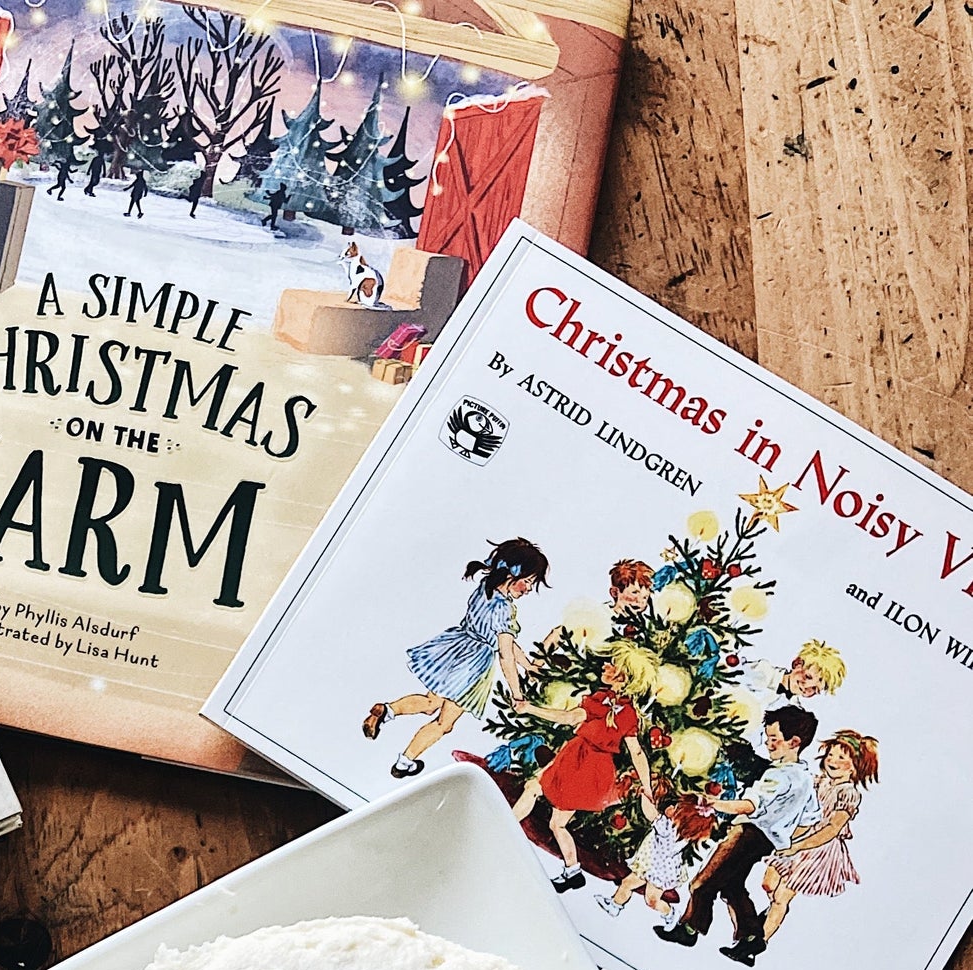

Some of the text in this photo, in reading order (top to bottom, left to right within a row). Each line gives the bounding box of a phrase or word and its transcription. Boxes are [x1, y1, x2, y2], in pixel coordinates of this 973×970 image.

[36, 272, 253, 352] A SIMPLE
[65, 416, 161, 454] ON THE
[487, 350, 703, 497] By ASTRID LINDGREN
[525, 287, 727, 435] Christmas
[733, 421, 782, 473] in
[793, 449, 924, 557] Noisy
[14, 602, 68, 628] Phyllis
[71, 615, 140, 642] Alsdurf
[845, 583, 884, 610] and
[883, 600, 942, 645] ILON
[54, 633, 74, 657] by
[75, 638, 109, 659] Lisa
[113, 646, 160, 669] Hunt
